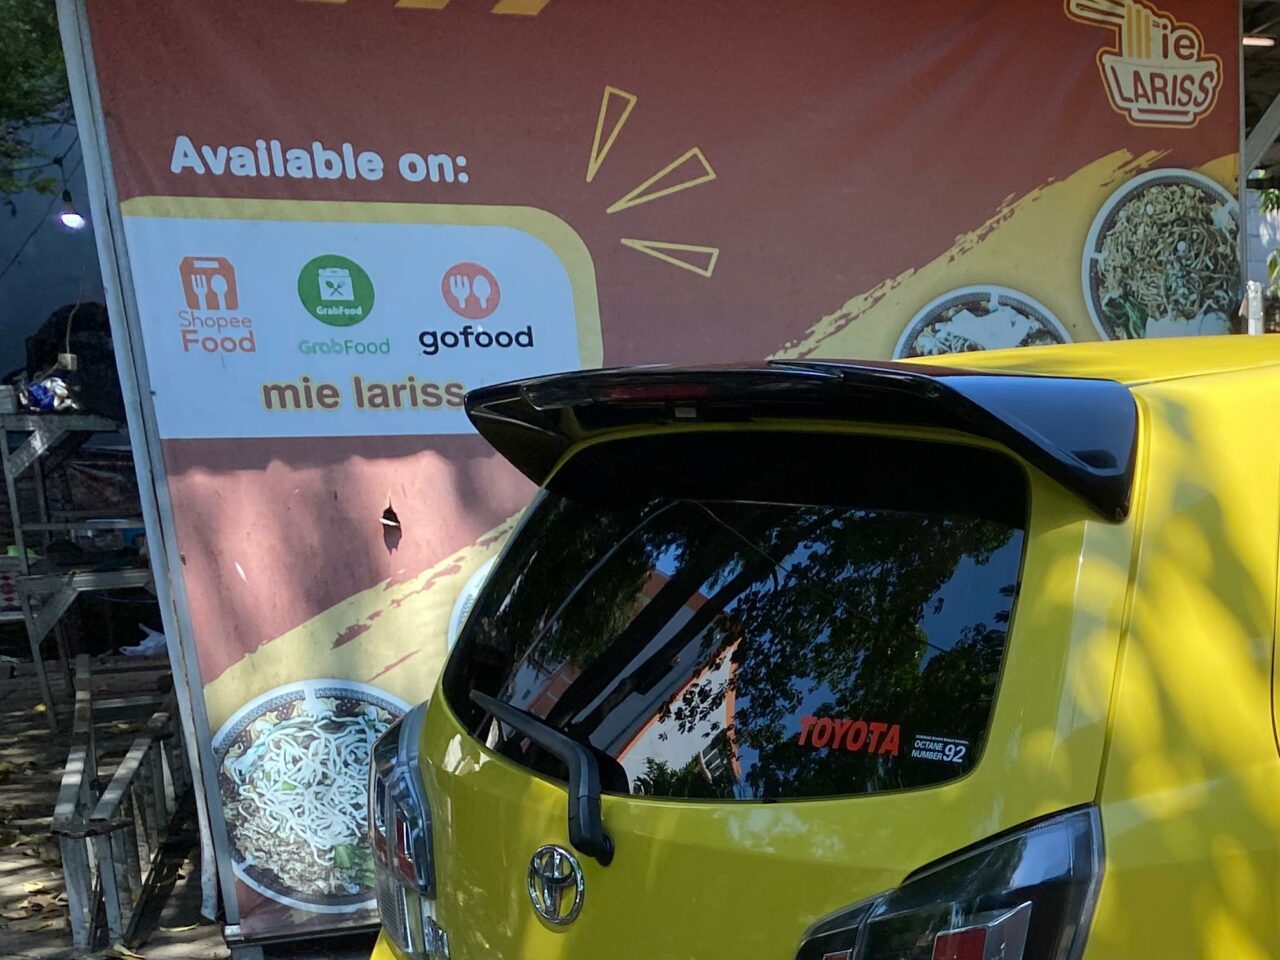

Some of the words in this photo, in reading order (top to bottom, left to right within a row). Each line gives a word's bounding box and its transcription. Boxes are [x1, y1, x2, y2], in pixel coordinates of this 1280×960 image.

[1110, 65, 1215, 108] LARISS
[170, 135, 384, 181] Available
[398, 152, 469, 183] on:
[179, 310, 252, 333] Shopee
[316, 305, 363, 316] GrabFood
[181, 329, 256, 353] Food
[298, 338, 391, 355] GrabFood
[418, 325, 535, 356] gofood
[261, 375, 342, 410] mie
[352, 374, 465, 410] lariss
[798, 716, 901, 757] TOYOTA
[914, 740, 944, 751] OCTANE
[911, 749, 943, 760] NUMBER
[943, 744, 966, 763] 92
